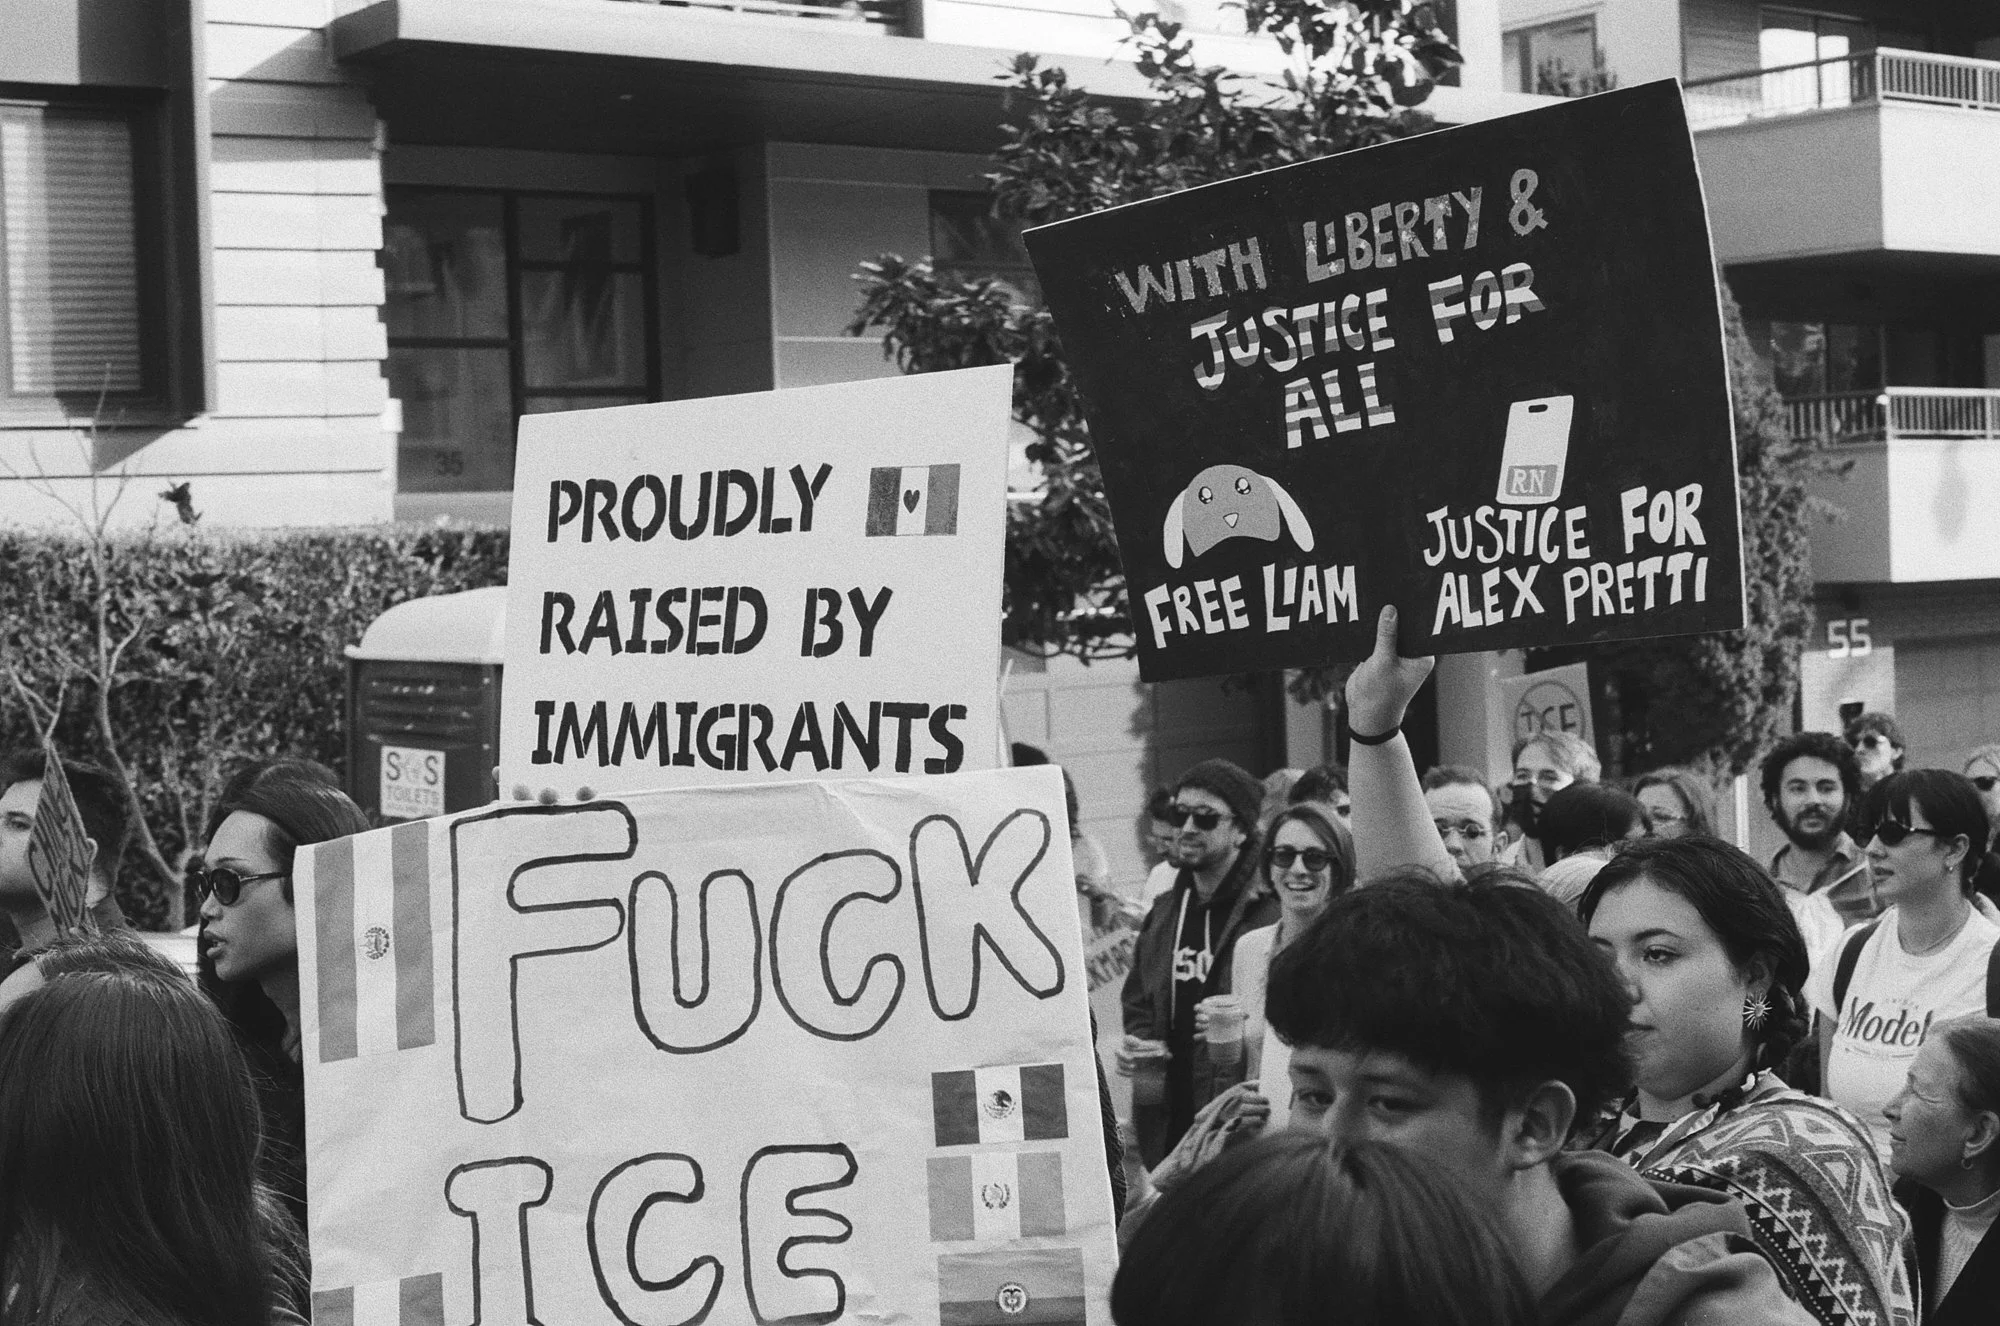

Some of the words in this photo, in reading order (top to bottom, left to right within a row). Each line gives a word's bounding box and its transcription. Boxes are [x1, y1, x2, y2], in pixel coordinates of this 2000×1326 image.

[1113, 237, 1268, 313] WITH
[1303, 186, 1483, 284] LIBERTY
[1509, 168, 1548, 237] &
[1190, 288, 1396, 391] JUSTICE
[1428, 262, 1545, 345] FOR
[1285, 362, 1396, 449] ALL
[547, 463, 833, 543] PROUDLY
[1511, 465, 1547, 495] RN
[1423, 504, 1592, 567] JUSTICE
[1621, 483, 1707, 554] FOR
[539, 586, 768, 656] RAISED
[801, 586, 893, 658] BY
[1144, 577, 1249, 649] FREE
[1263, 563, 1360, 633] LIAM
[1431, 564, 1545, 635] ALEX
[1563, 556, 1709, 625] PRETTI
[1828, 618, 1872, 658] 55
[531, 700, 968, 775] IMMIGRANTS
[450, 799, 1065, 1124] FUCK
[444, 1142, 858, 1326] ICE
